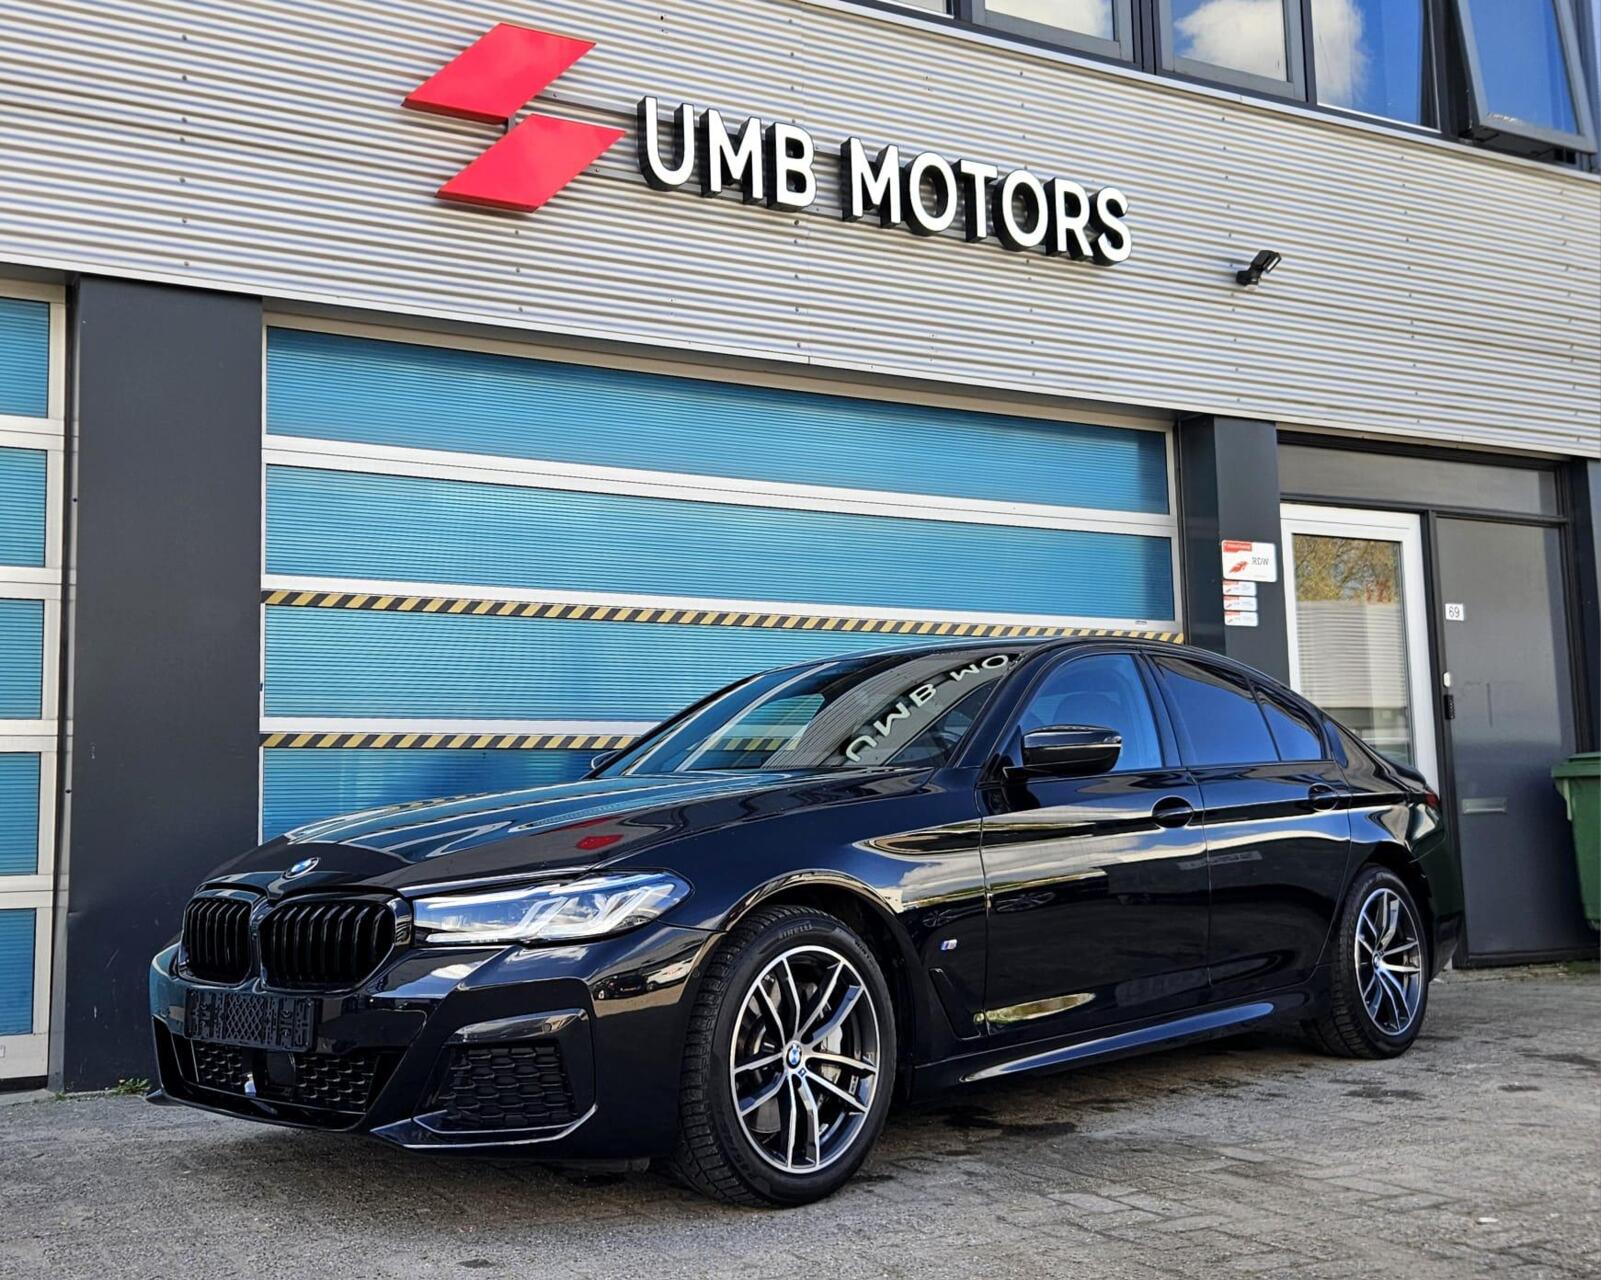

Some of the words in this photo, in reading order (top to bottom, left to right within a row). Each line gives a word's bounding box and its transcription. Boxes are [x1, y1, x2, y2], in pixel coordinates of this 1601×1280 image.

[638, 96, 816, 212] UMB
[841, 137, 1132, 266] MOTORS
[1448, 606, 1460, 618] 69
